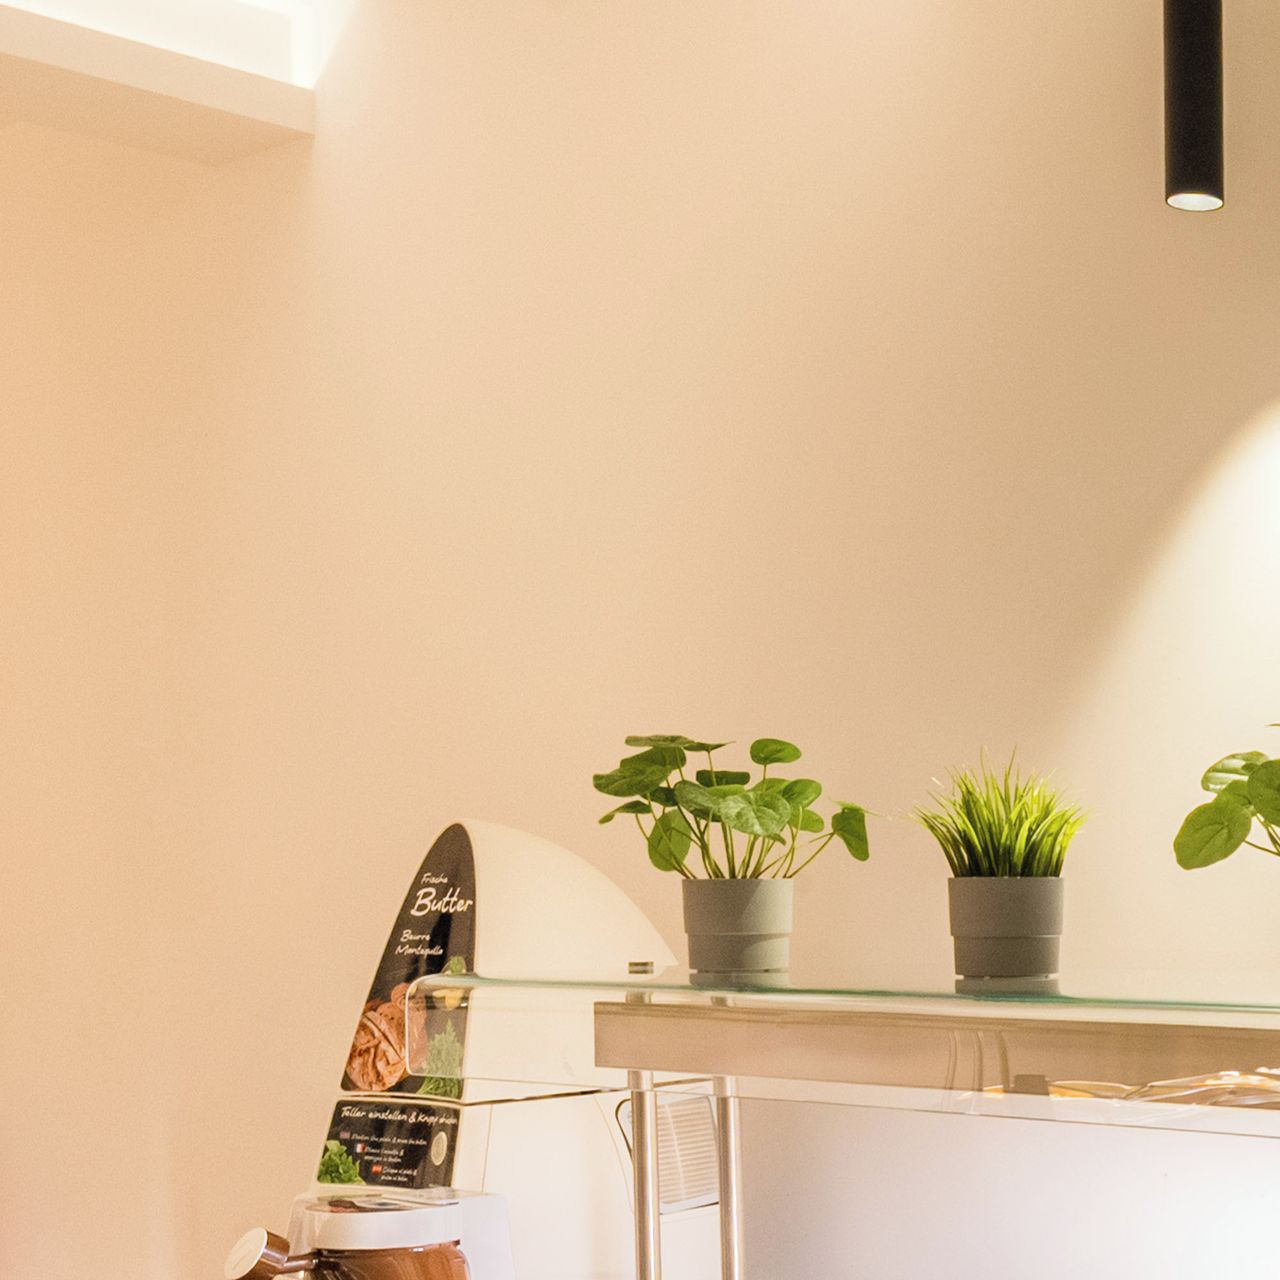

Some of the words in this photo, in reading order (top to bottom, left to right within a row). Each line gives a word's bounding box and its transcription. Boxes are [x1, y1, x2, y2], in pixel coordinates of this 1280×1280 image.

[410, 887, 473, 916] Butter
[400, 929, 431, 942] Beurre
[341, 1106, 366, 1118] Teller
